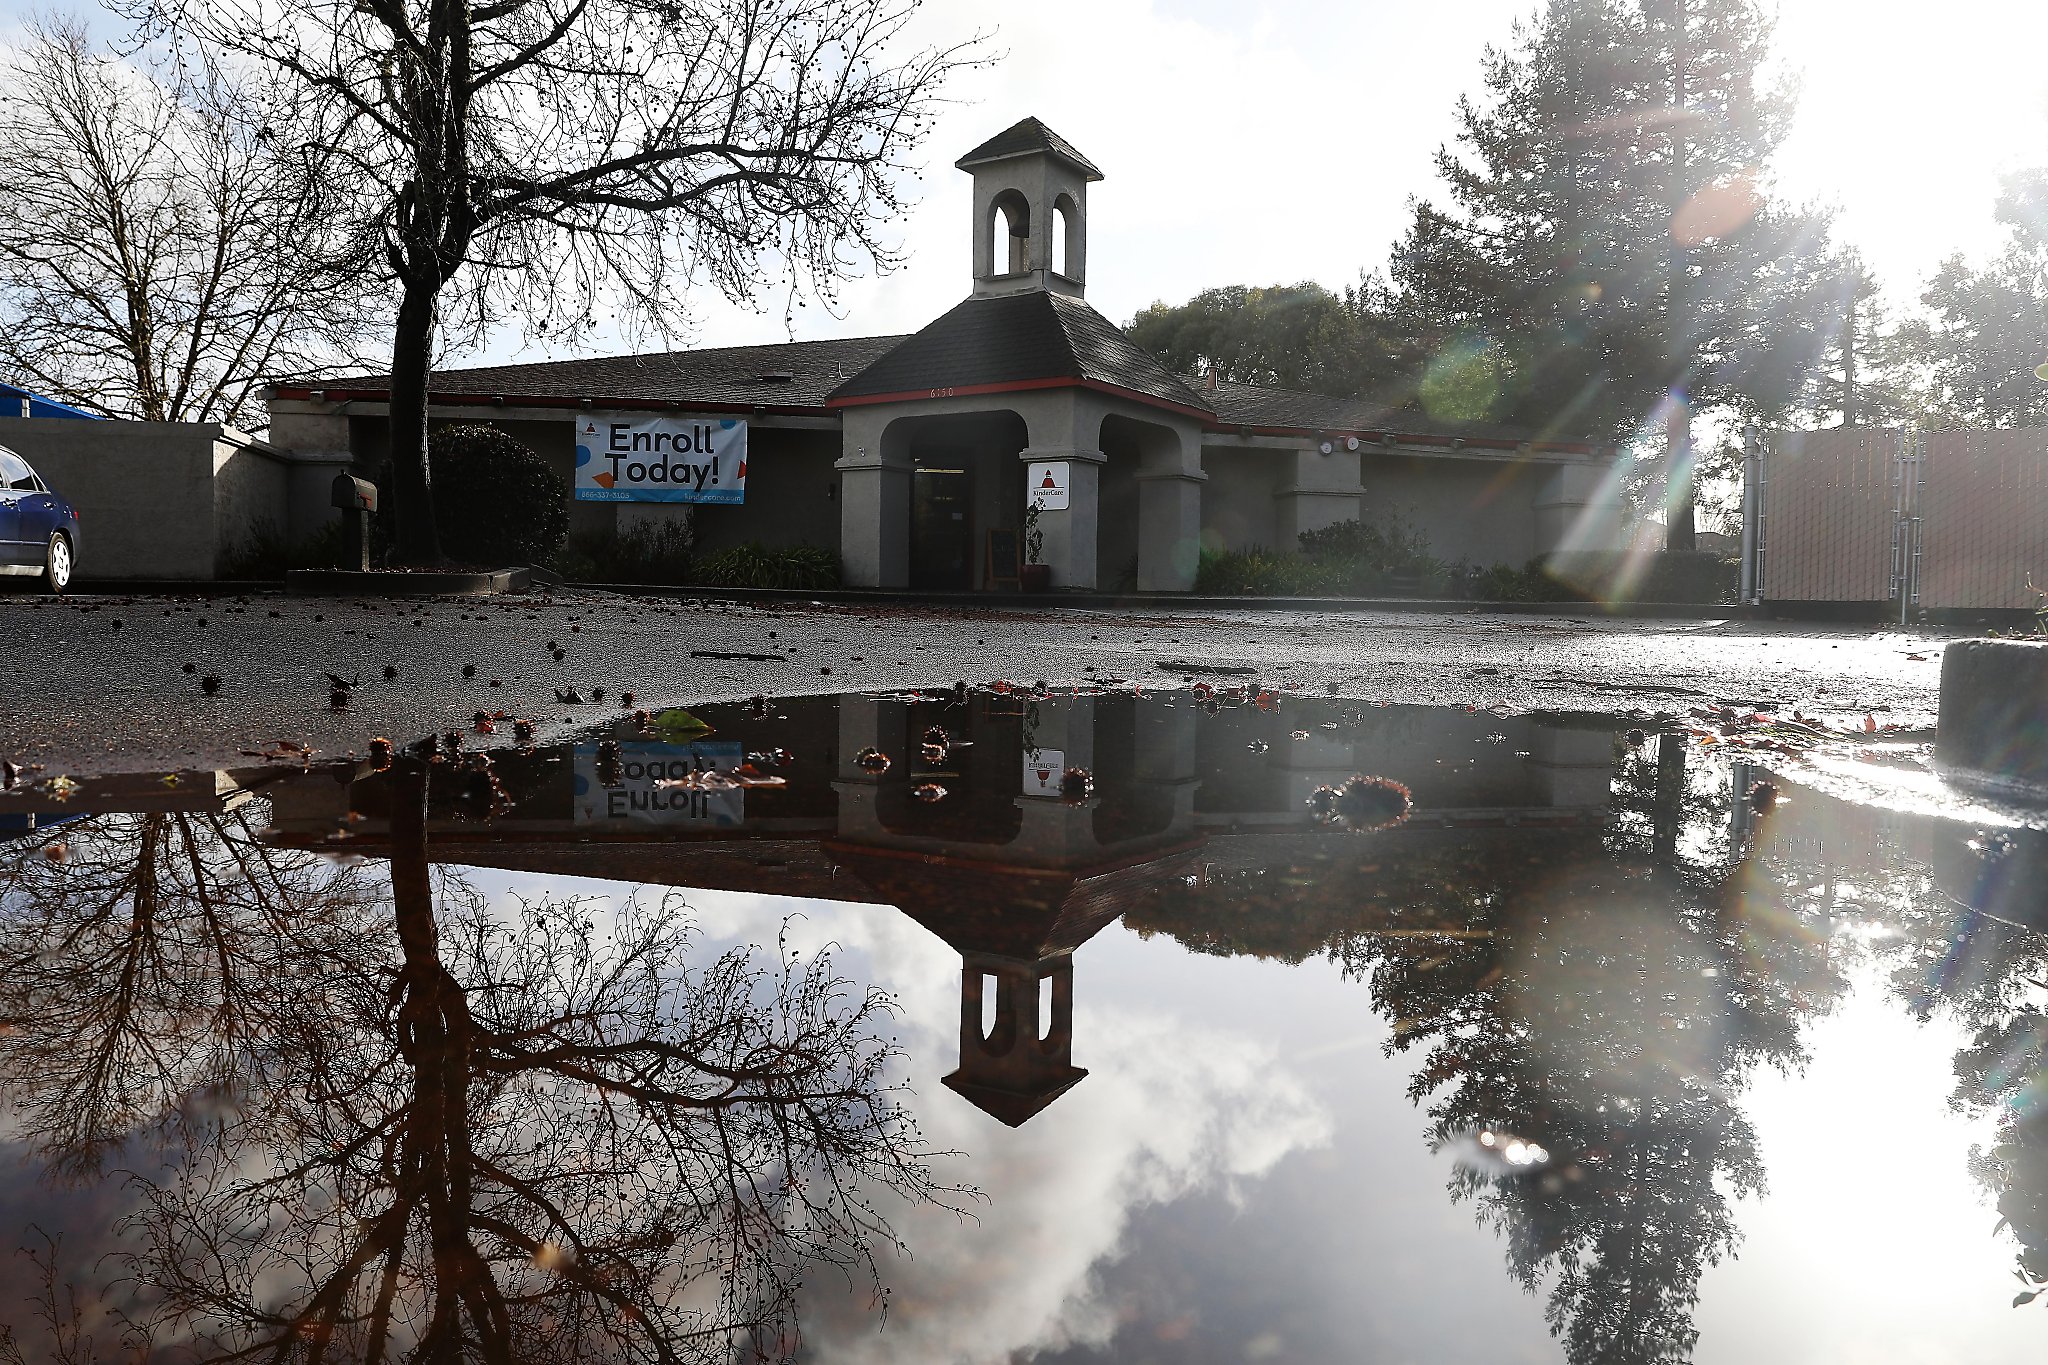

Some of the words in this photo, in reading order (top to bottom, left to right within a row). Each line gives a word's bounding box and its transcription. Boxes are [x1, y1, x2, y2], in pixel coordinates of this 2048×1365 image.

[931, 388, 953, 398] 6150
[610, 424, 714, 453] Enroll
[604, 453, 719, 492] Today!
